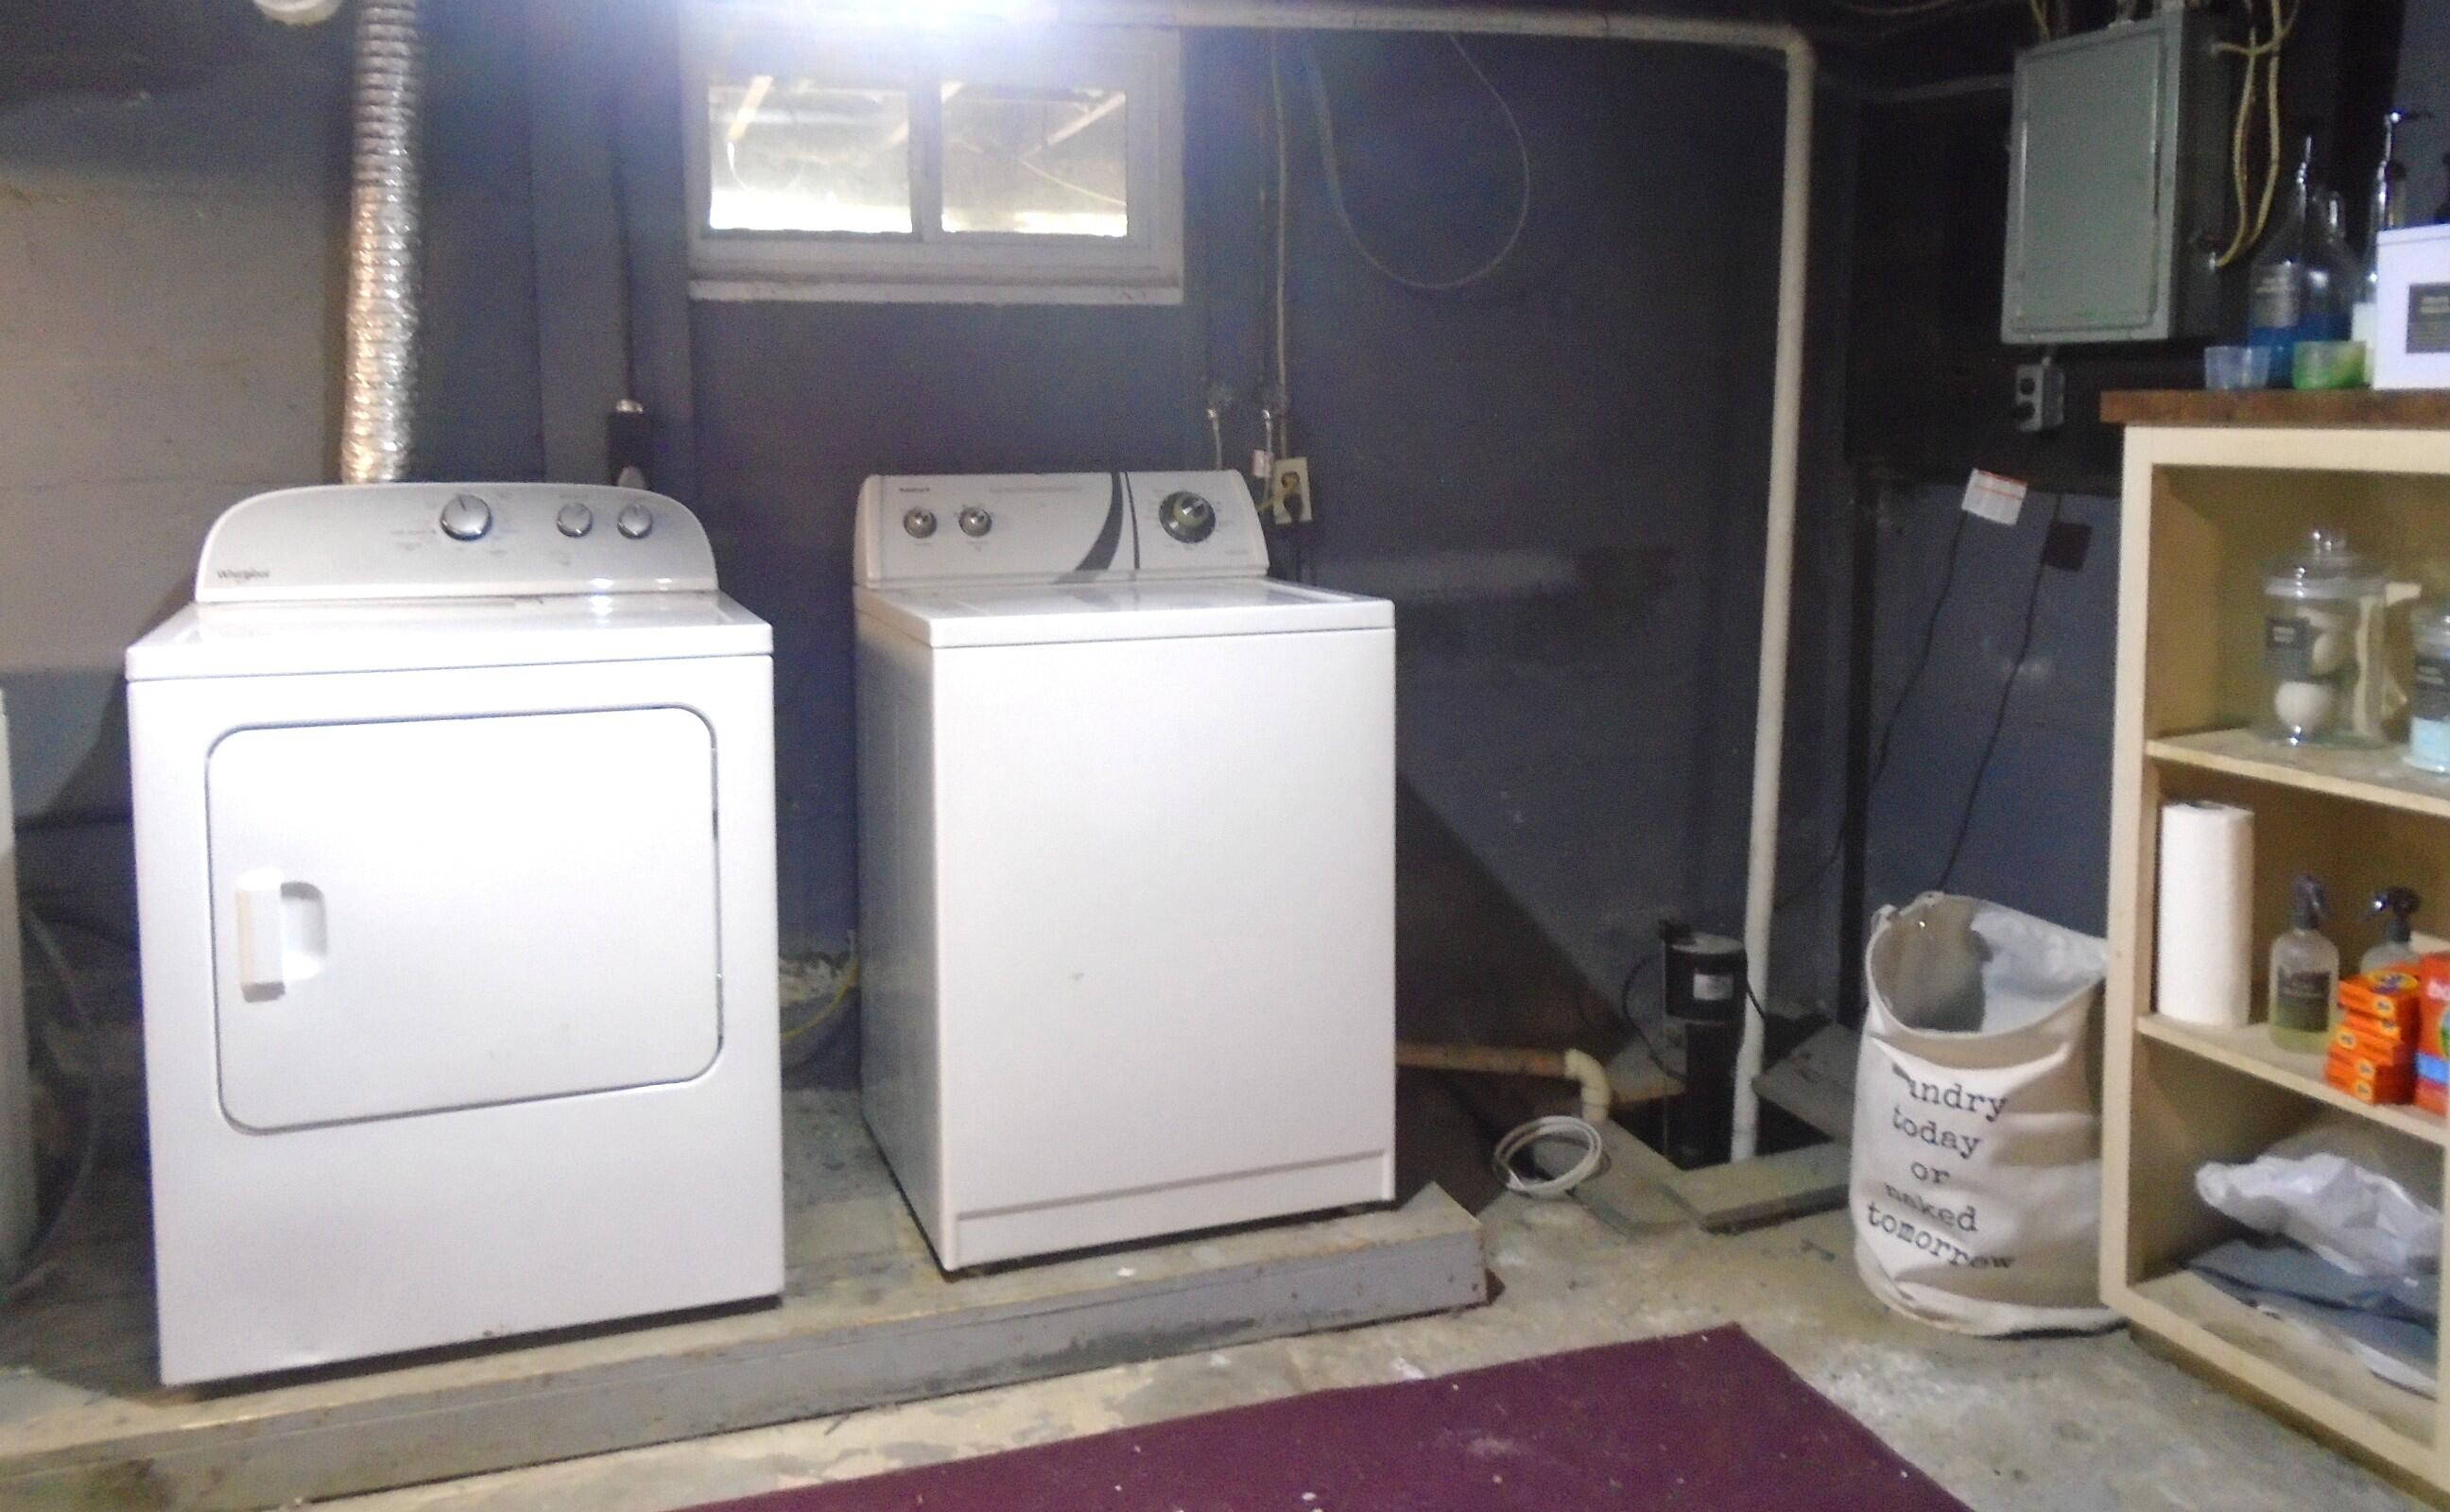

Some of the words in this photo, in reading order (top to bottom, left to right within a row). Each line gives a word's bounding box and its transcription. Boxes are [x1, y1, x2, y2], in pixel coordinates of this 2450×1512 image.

[1892, 1104, 1982, 1160] today
[1910, 1160, 1951, 1183] or
[1867, 1201, 2016, 1268] tomorrow
